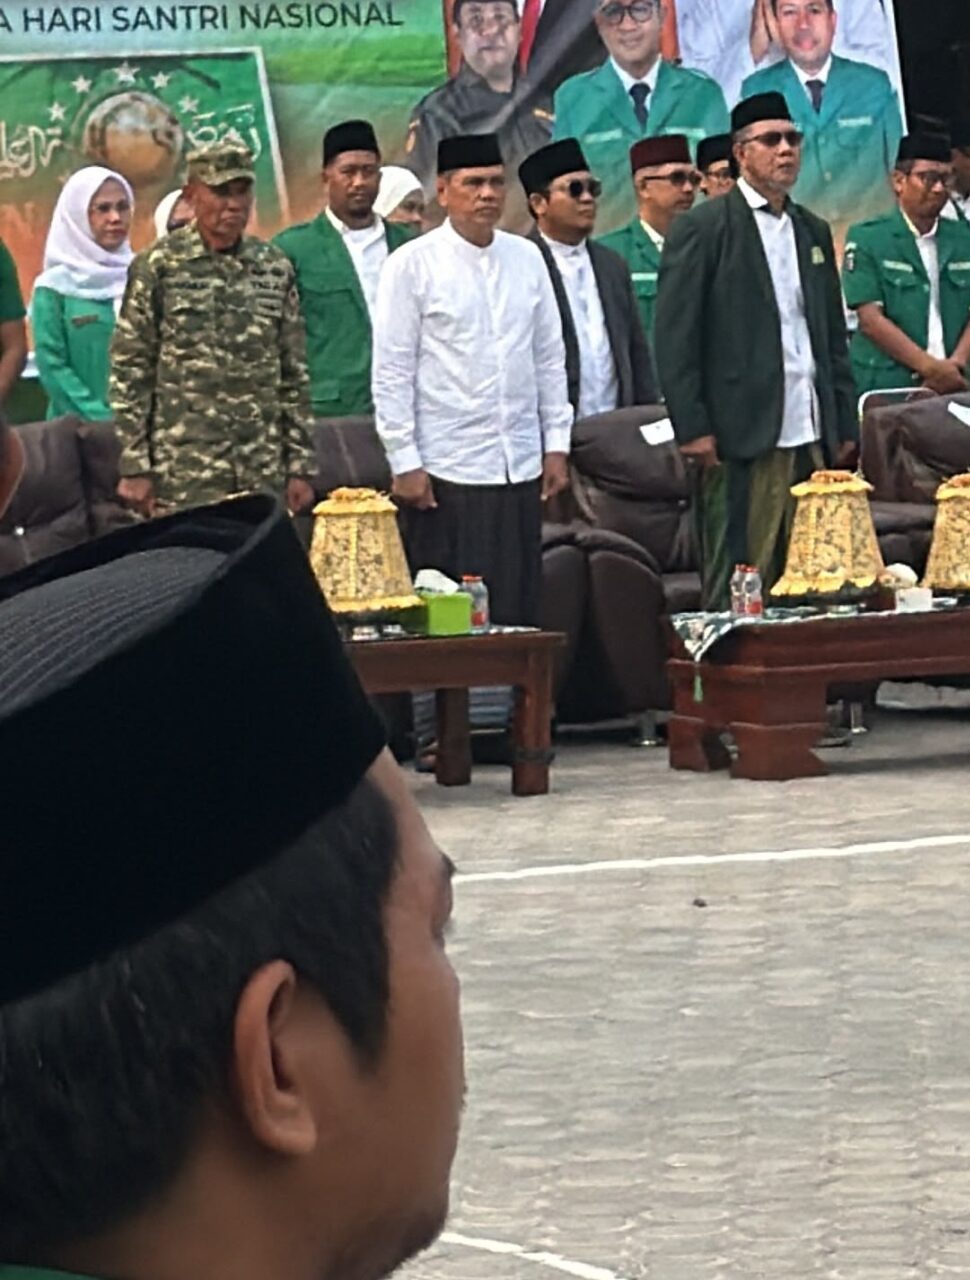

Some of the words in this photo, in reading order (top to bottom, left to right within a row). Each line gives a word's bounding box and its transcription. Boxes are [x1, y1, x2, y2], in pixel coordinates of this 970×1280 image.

[23, 6, 101, 33] HARI
[112, 4, 228, 32] SANTRI
[240, 1, 405, 30] NASIONAL
